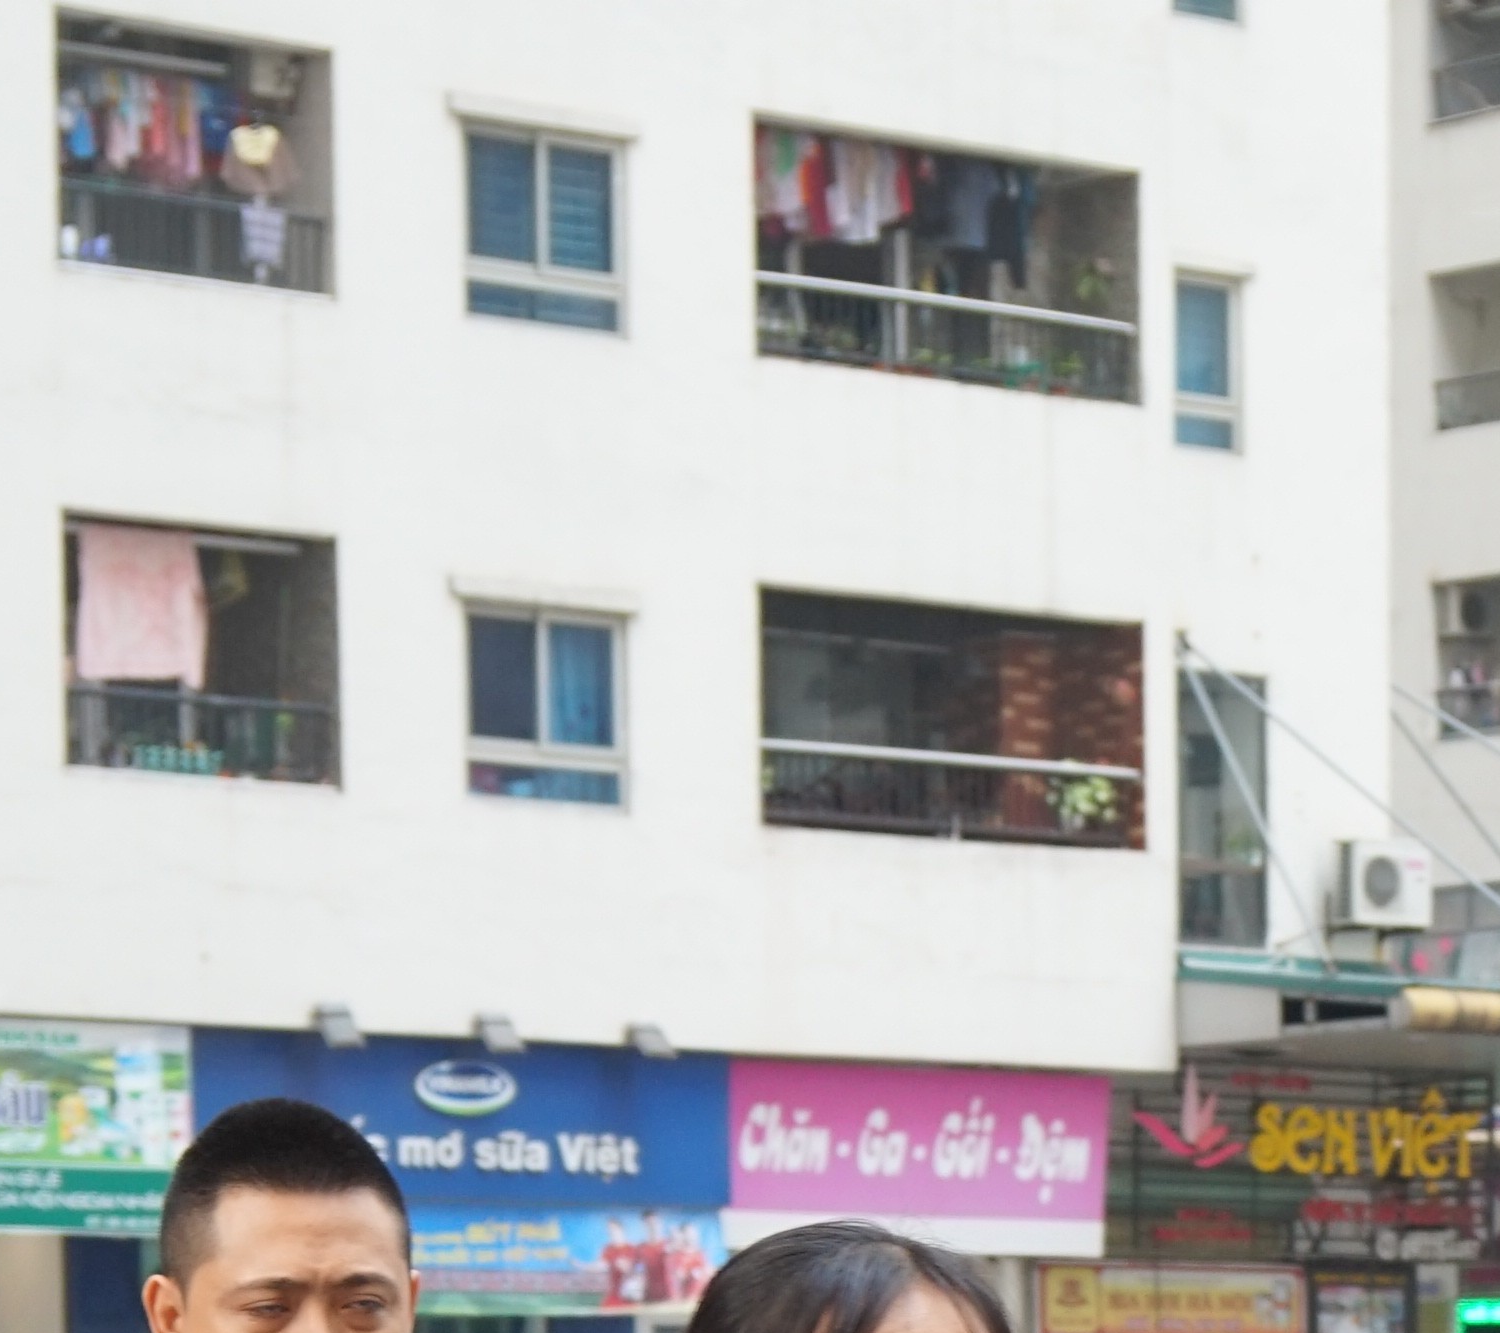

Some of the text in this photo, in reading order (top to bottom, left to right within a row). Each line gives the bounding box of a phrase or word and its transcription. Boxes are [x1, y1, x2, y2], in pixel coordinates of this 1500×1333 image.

[398, 1127, 465, 1169] mơ
[473, 1130, 548, 1175] sữa
[556, 1132, 639, 1181] Việt
[739, 1097, 1091, 1206] Chăn Ga Gối Đệm
